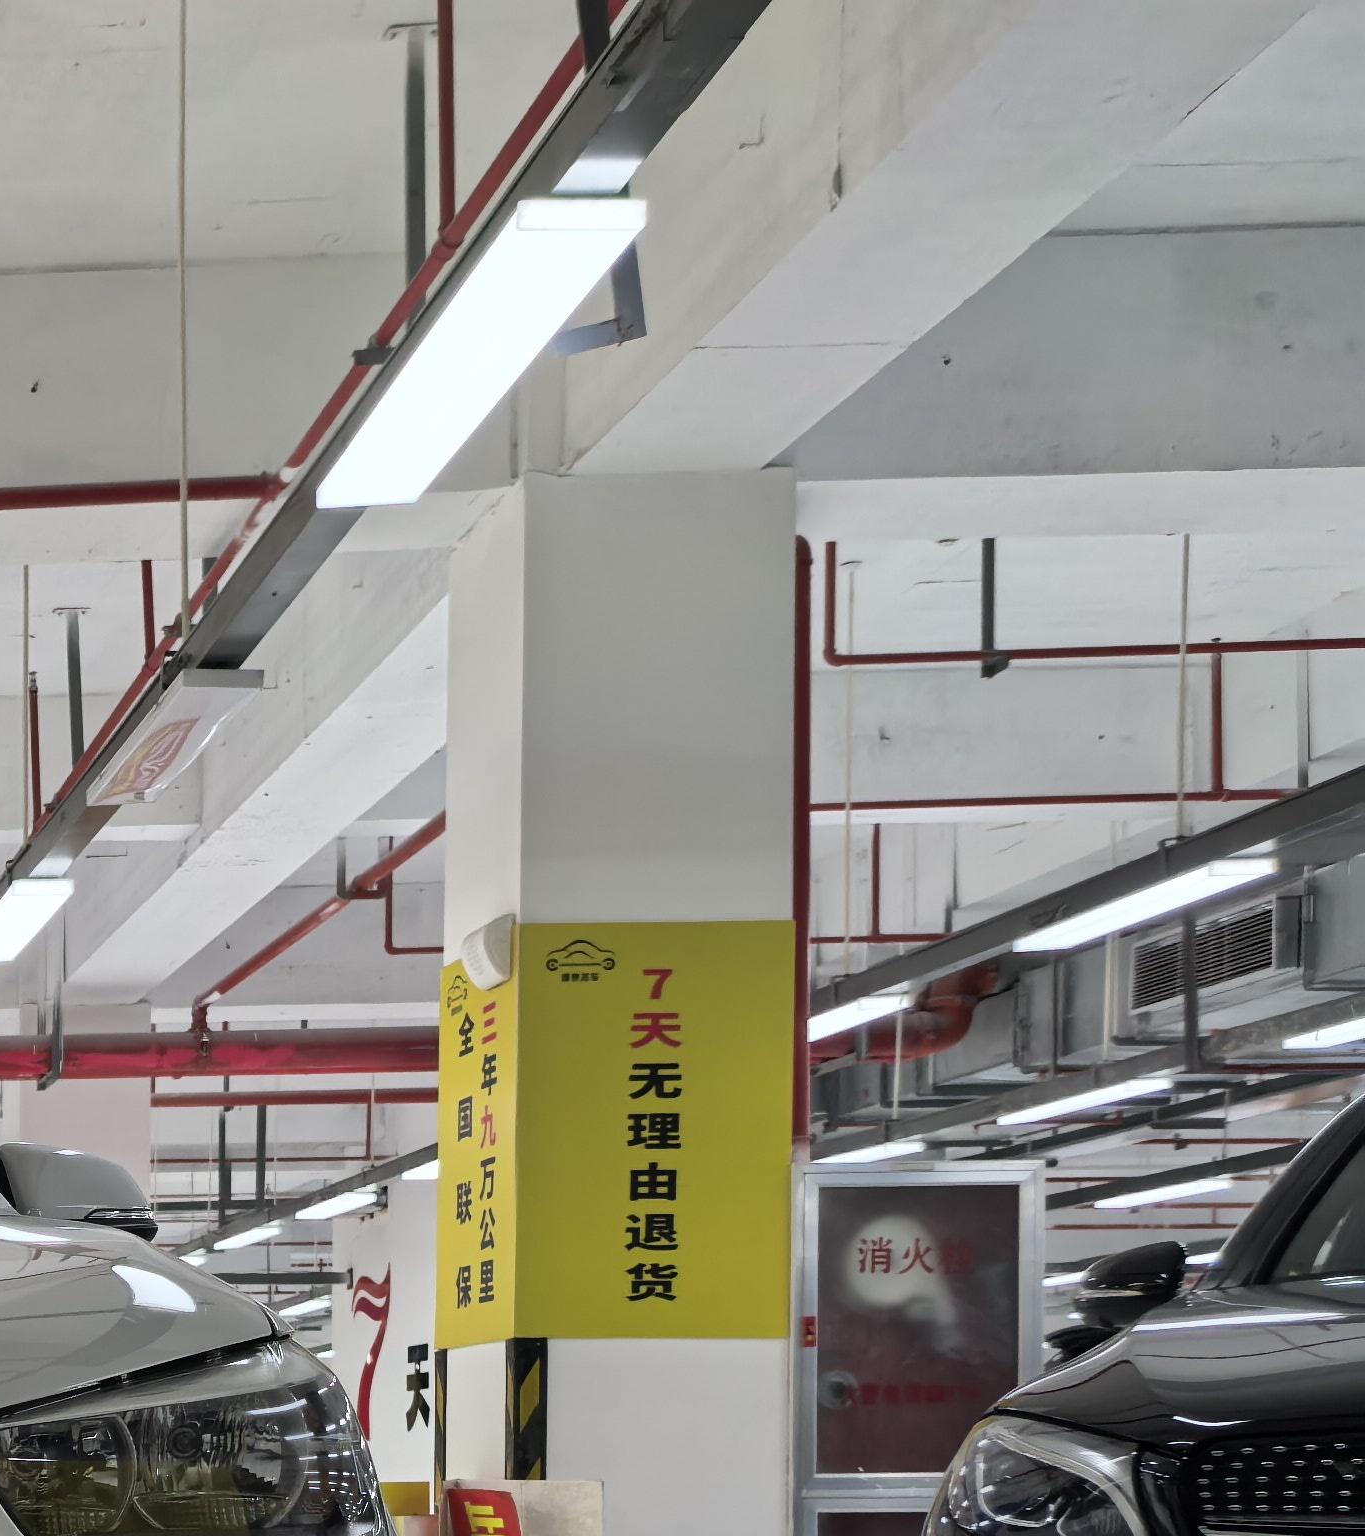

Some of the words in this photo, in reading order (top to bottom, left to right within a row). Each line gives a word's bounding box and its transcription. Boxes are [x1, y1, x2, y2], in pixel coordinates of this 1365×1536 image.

[455, 1012, 475, 1309] 全国联保
[478, 1000, 498, 1305] 三年九万公里
[625, 968, 683, 1302] 7天无理由退货
[857, 1236, 975, 1275] 消火
